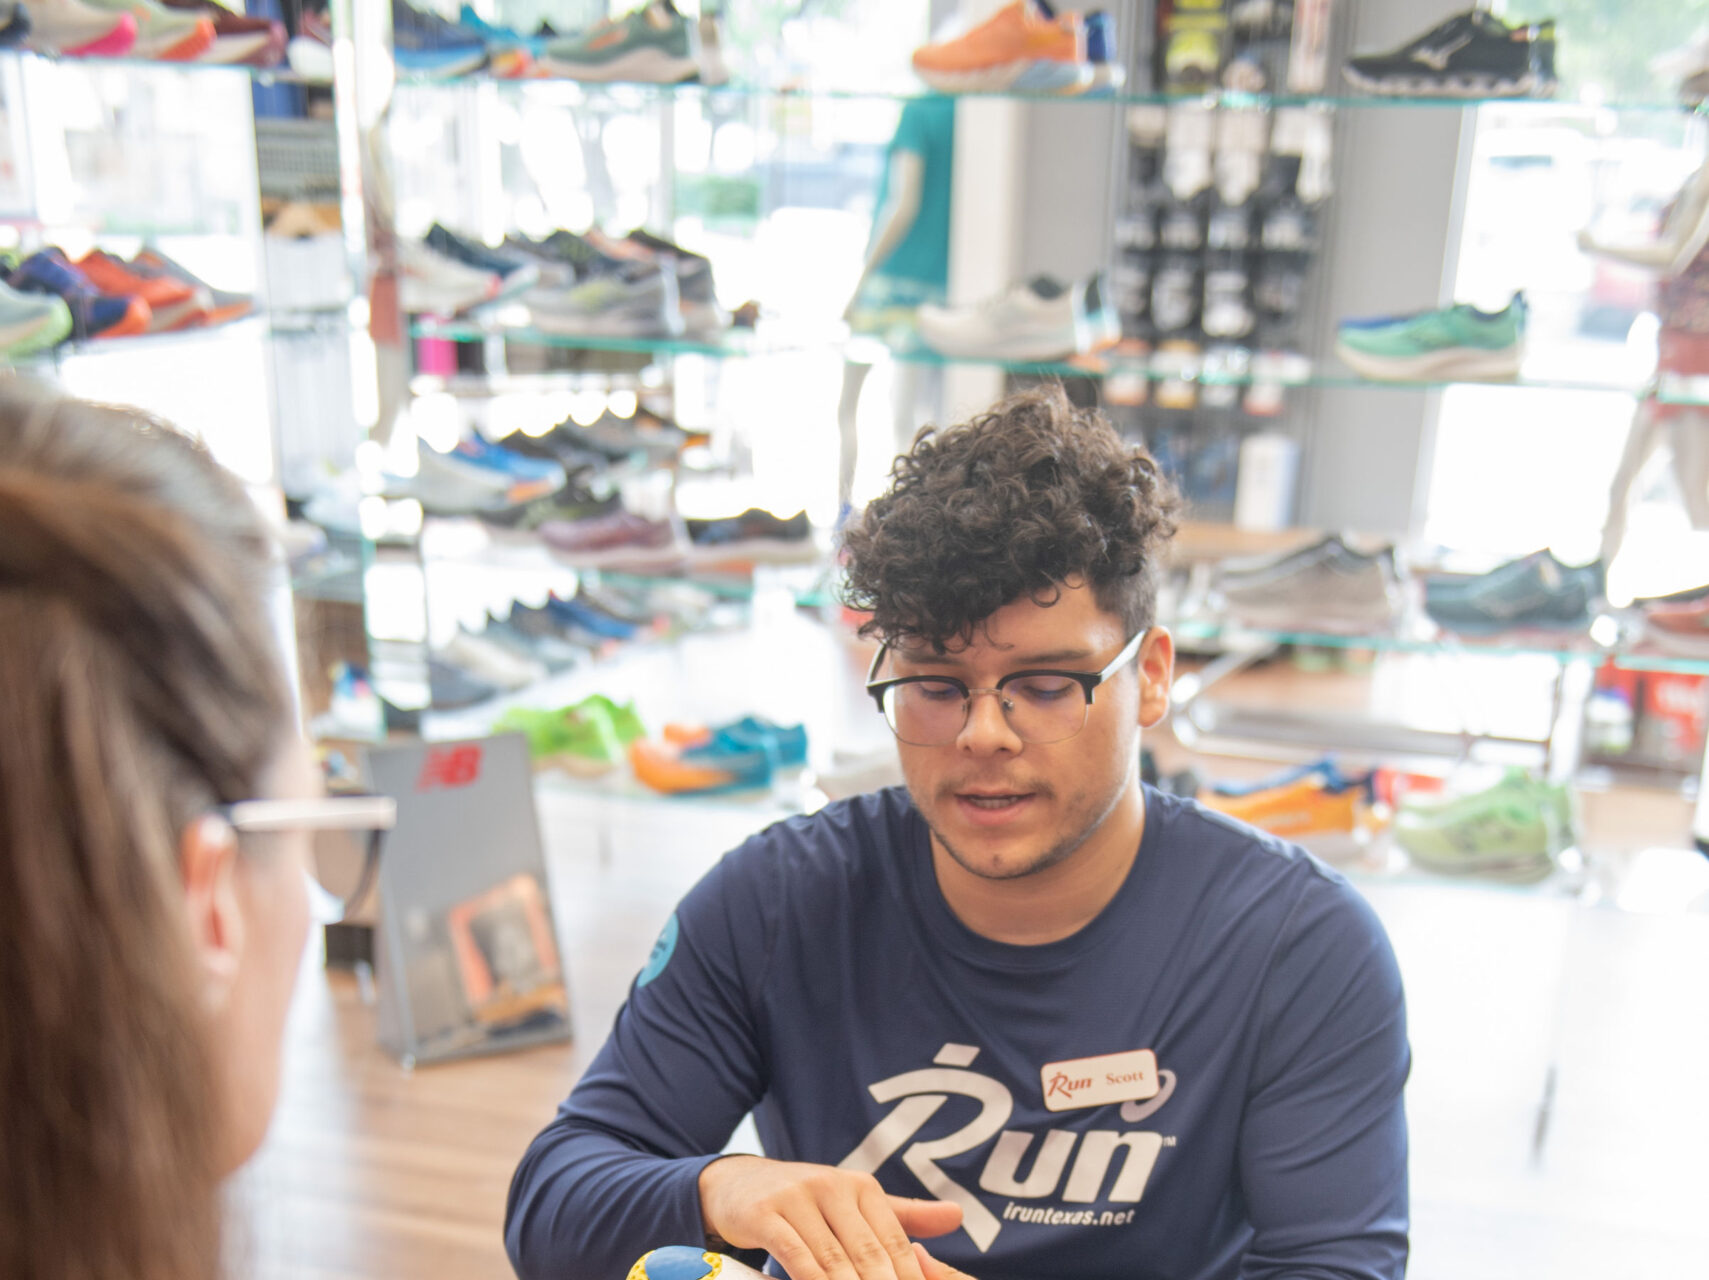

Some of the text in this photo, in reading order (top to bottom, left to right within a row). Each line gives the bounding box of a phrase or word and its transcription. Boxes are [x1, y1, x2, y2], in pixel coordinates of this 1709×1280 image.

[1048, 1071, 1144, 1098] Run Scott
[1003, 1201, 1135, 1226] iruntexas.net
